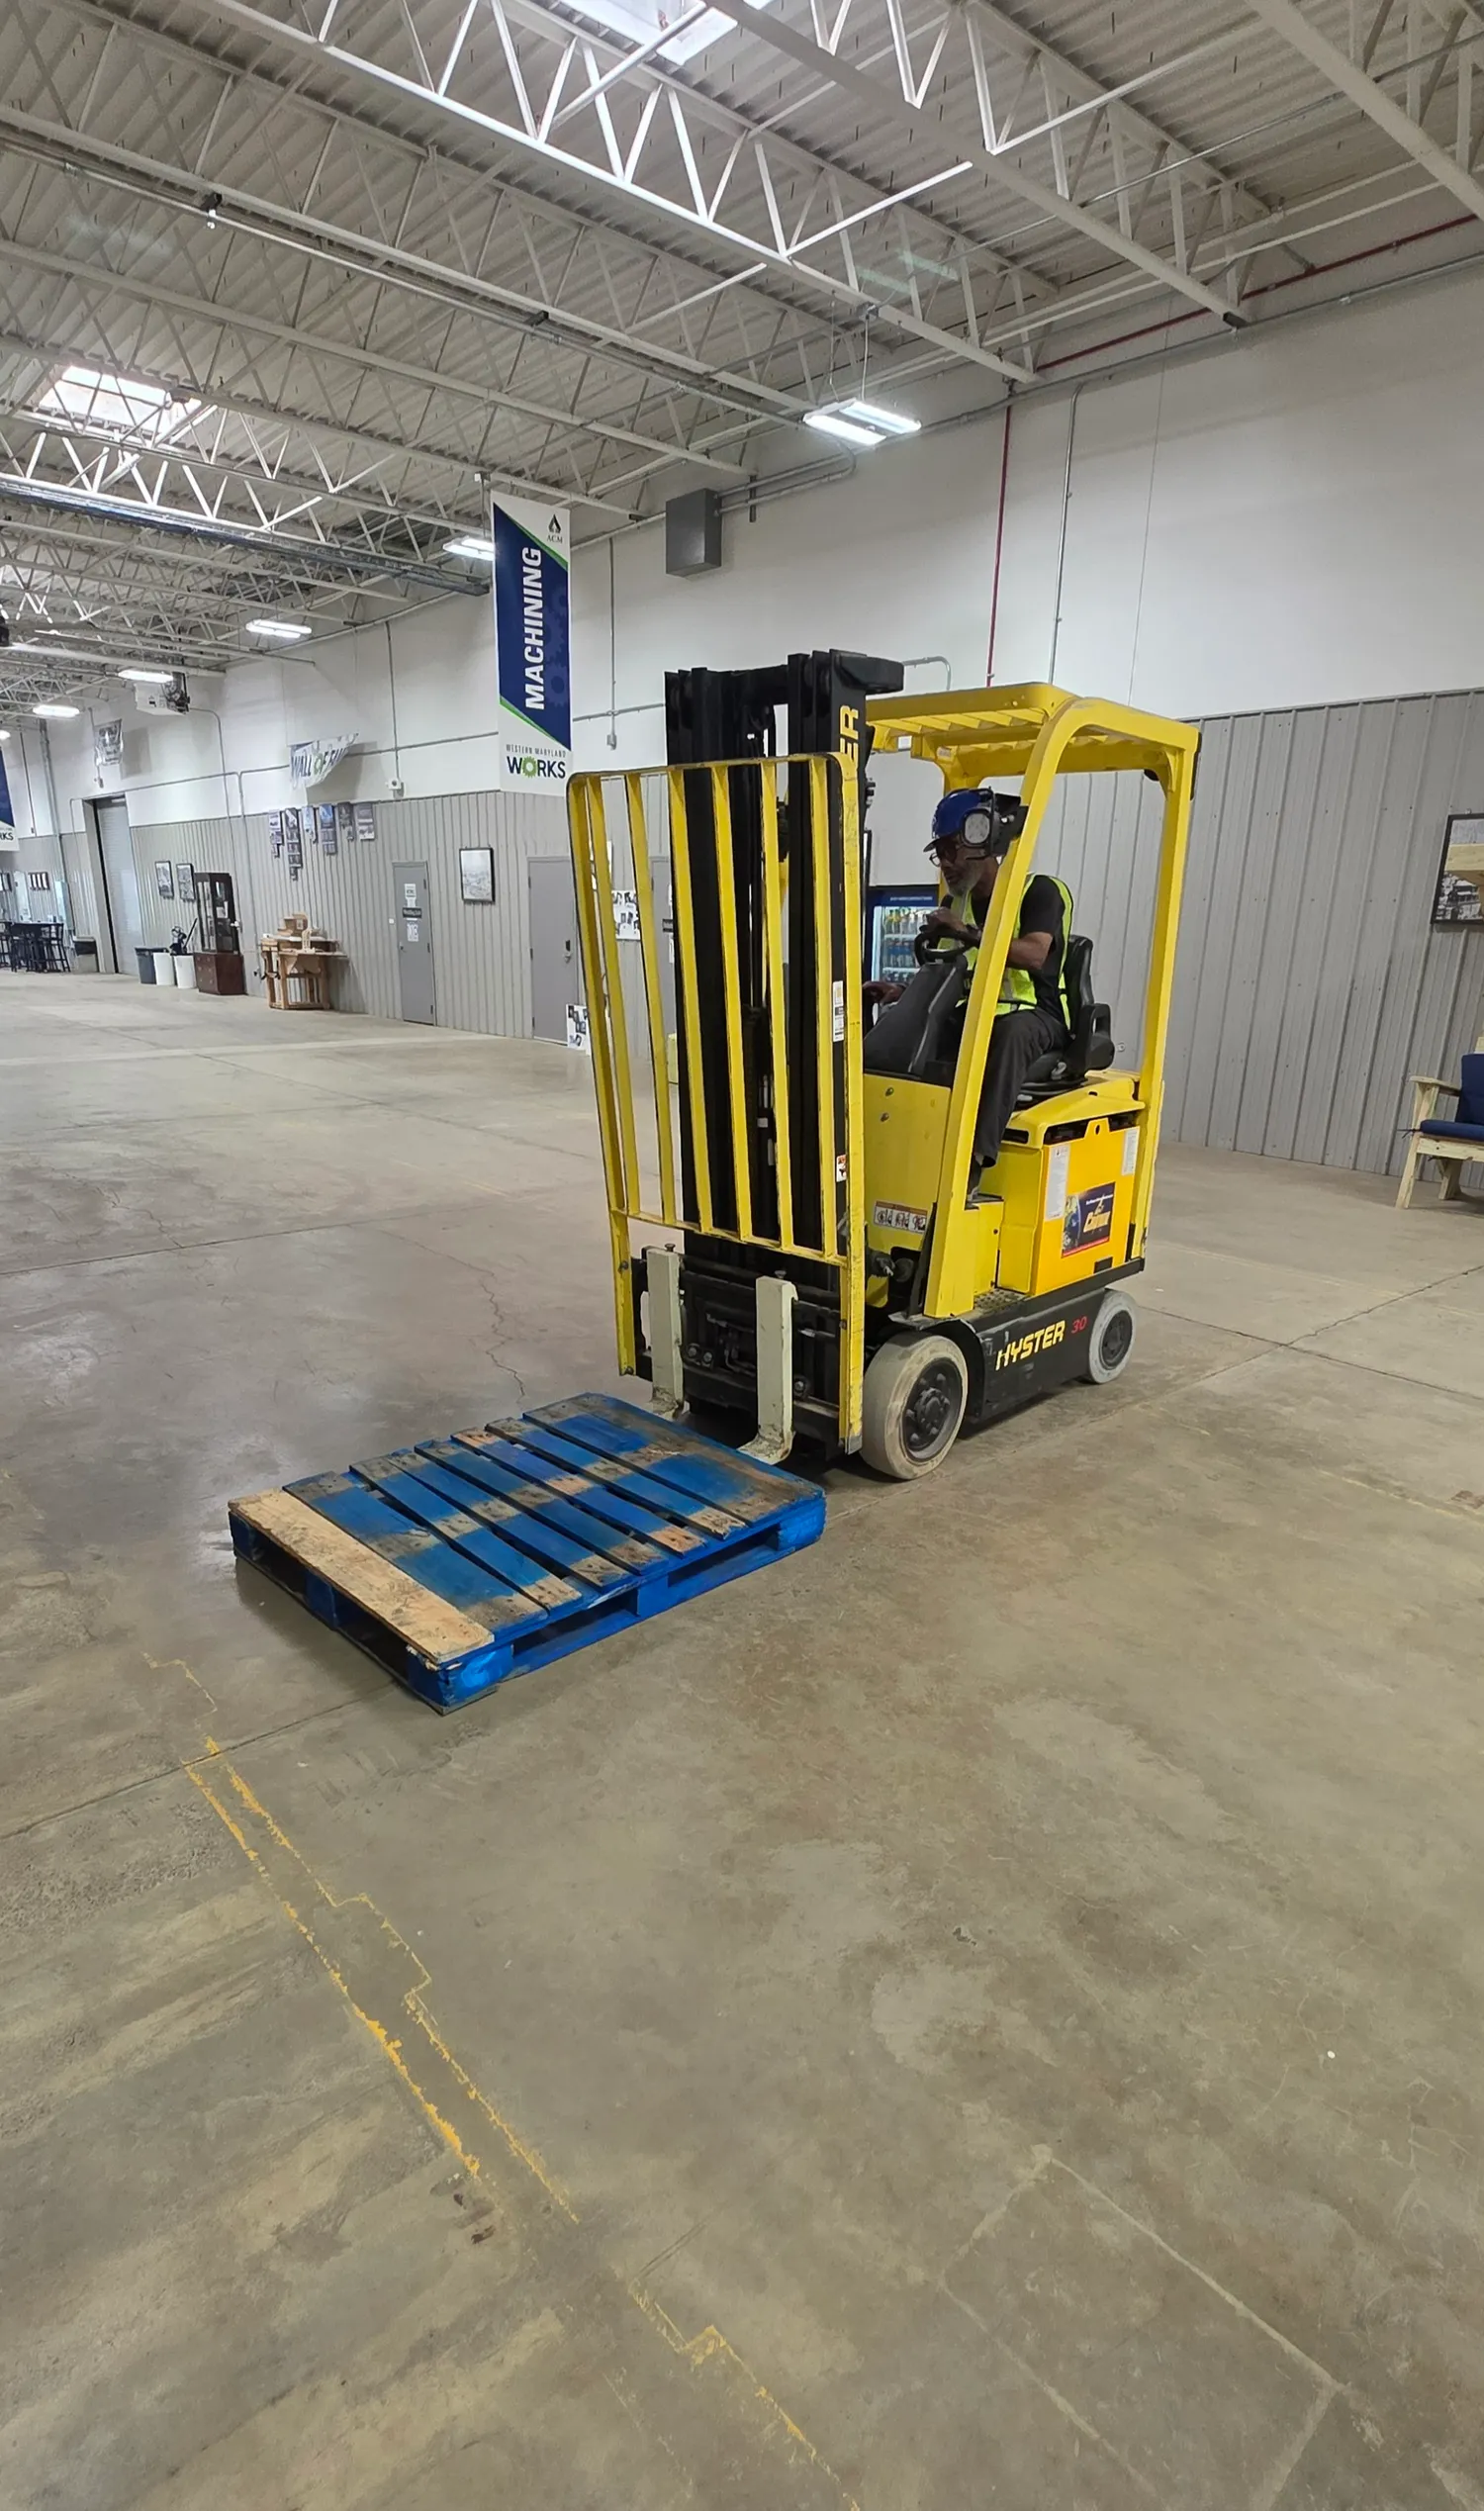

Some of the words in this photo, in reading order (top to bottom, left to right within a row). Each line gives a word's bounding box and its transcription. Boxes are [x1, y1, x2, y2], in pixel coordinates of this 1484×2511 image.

[547, 535, 563, 544] ACM
[522, 547, 544, 710] MACHINING
[506, 744, 533, 754] WESTERN
[534, 748, 567, 758] MARYLAND
[506, 756, 566, 779] WORKS
[995, 1320, 1067, 1371] HYSTER
[1071, 1316, 1088, 1334] 30
